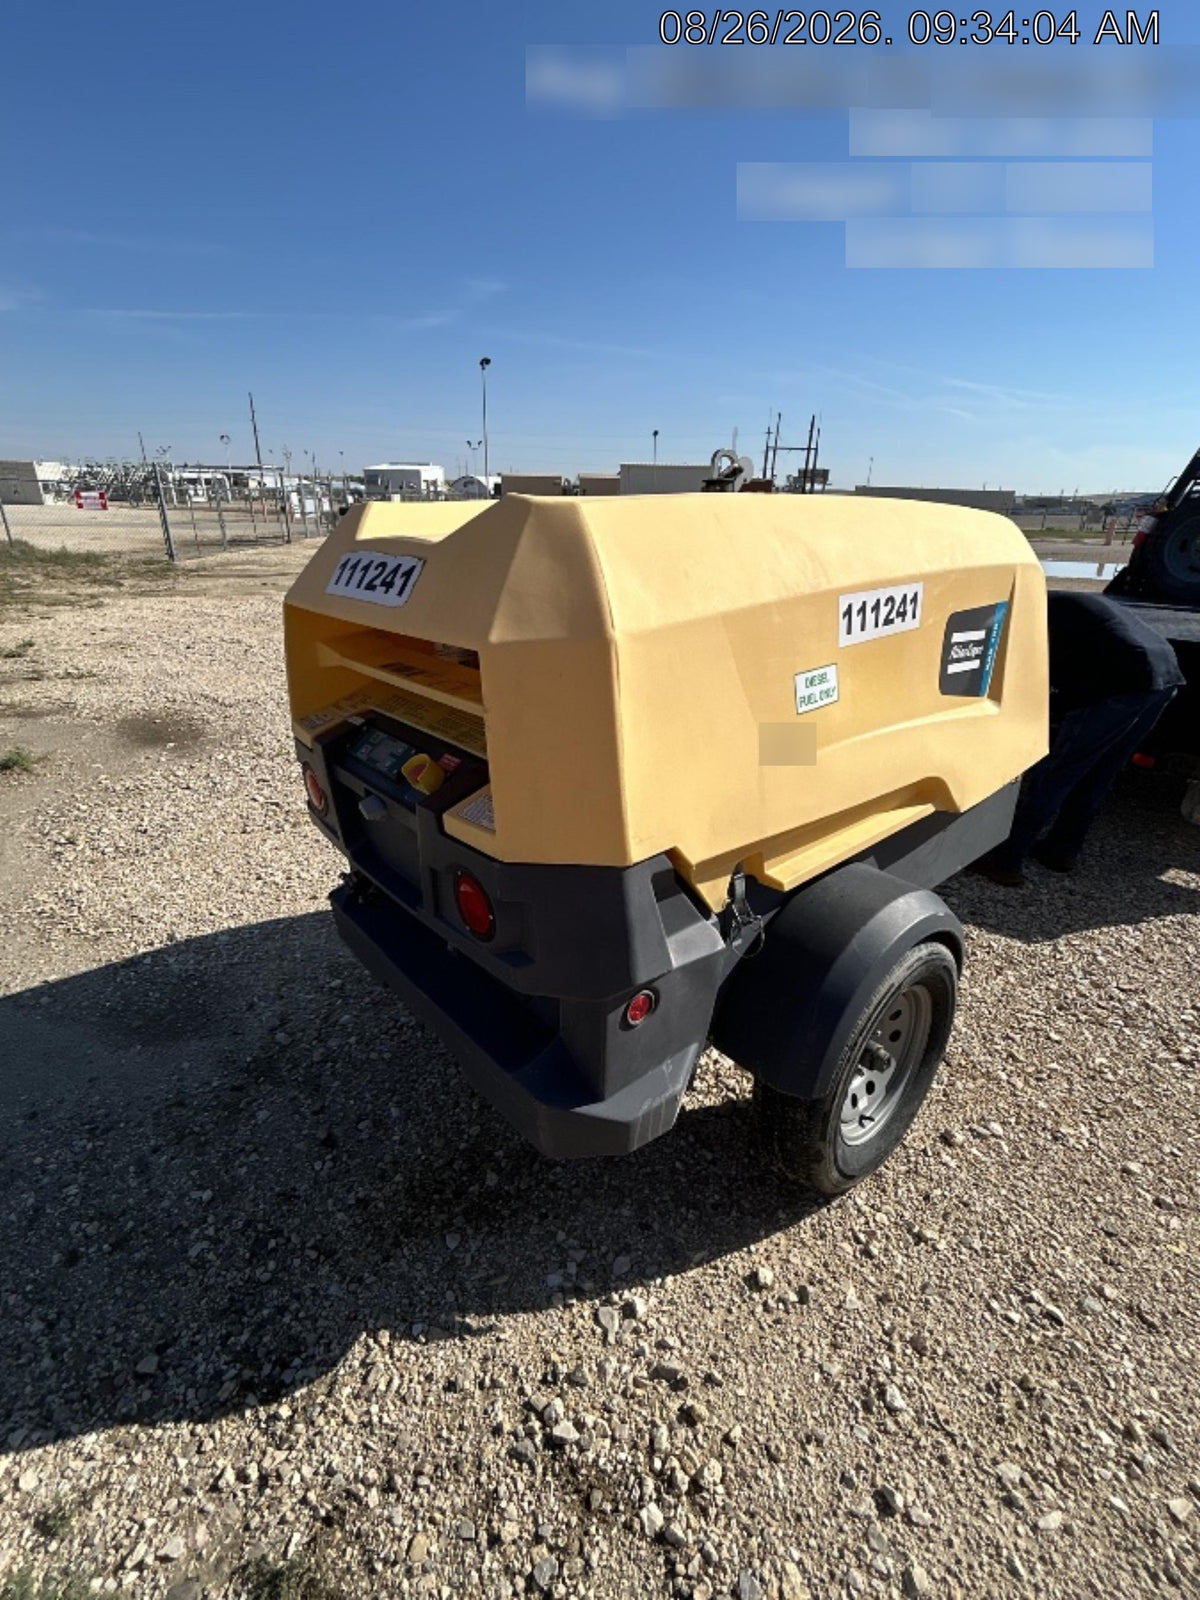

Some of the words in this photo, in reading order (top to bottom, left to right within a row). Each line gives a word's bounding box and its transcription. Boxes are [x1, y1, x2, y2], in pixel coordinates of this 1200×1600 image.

[334, 558, 417, 597] 111241
[842, 591, 918, 635] 111241
[799, 692, 818, 708] FUEL
